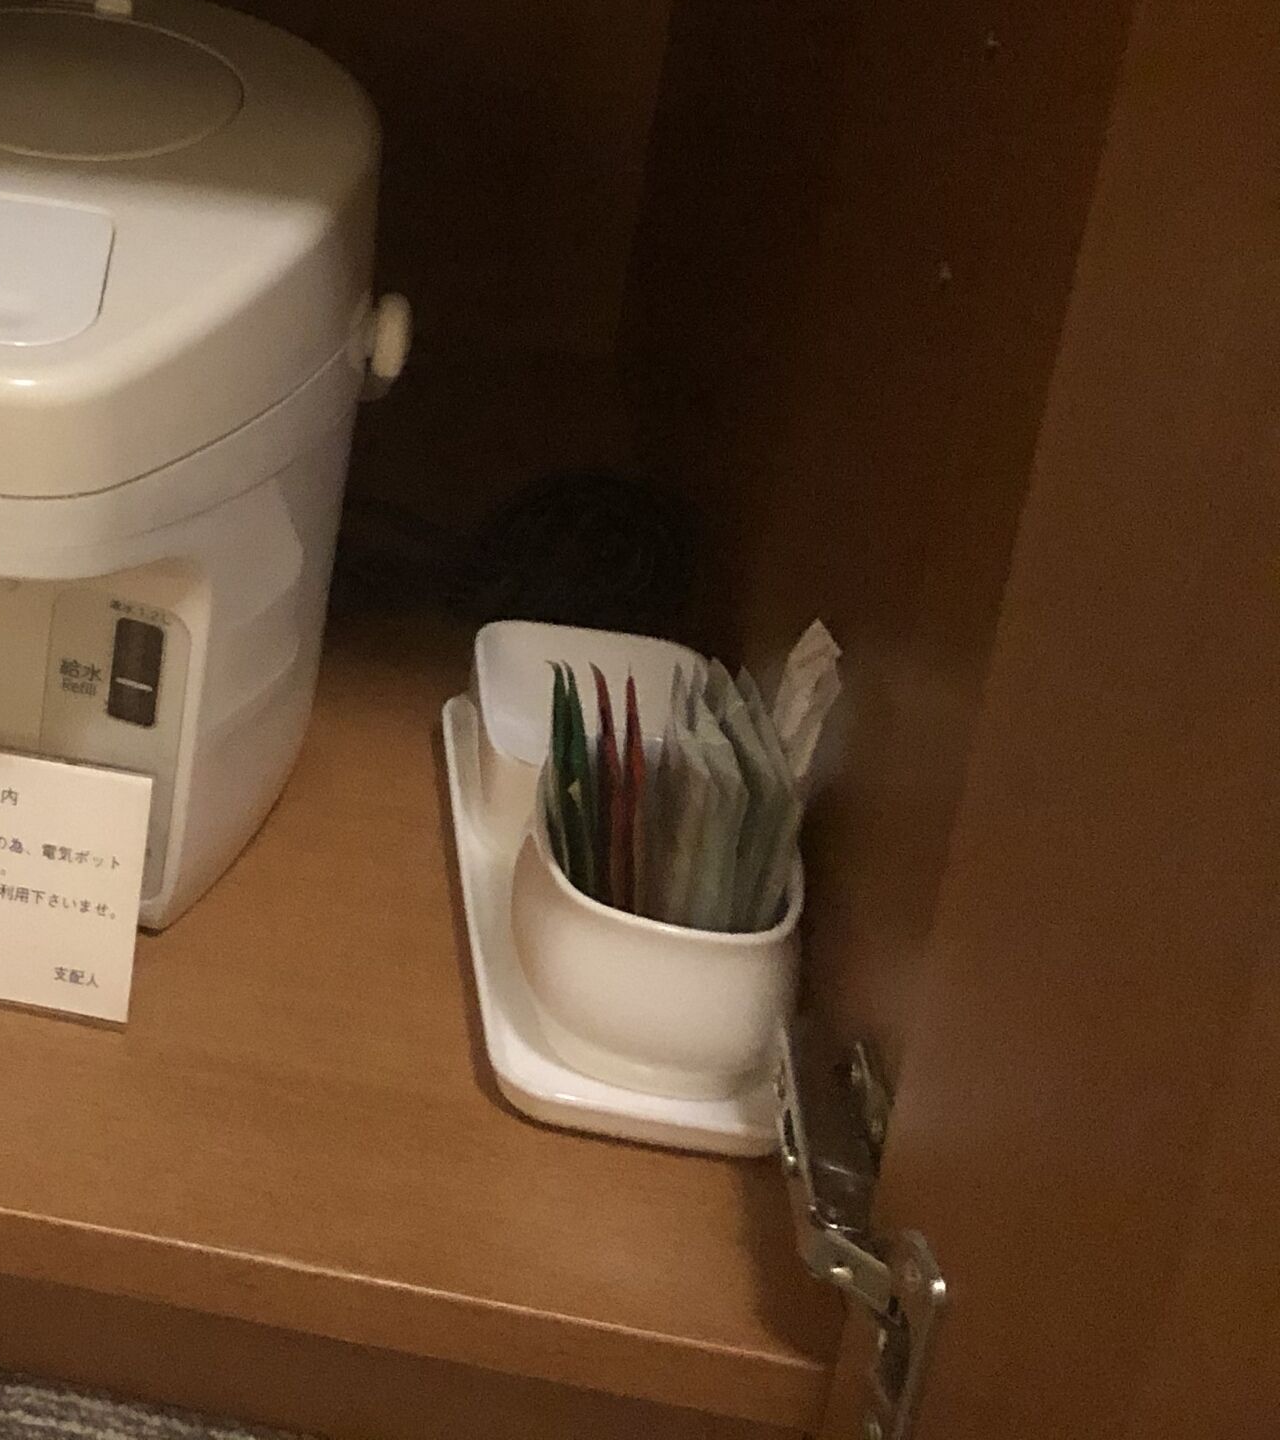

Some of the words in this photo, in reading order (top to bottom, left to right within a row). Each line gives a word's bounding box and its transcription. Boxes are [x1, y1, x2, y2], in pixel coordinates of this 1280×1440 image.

[60, 659, 103, 682] 給水
[53, 966, 99, 989] 支配人
